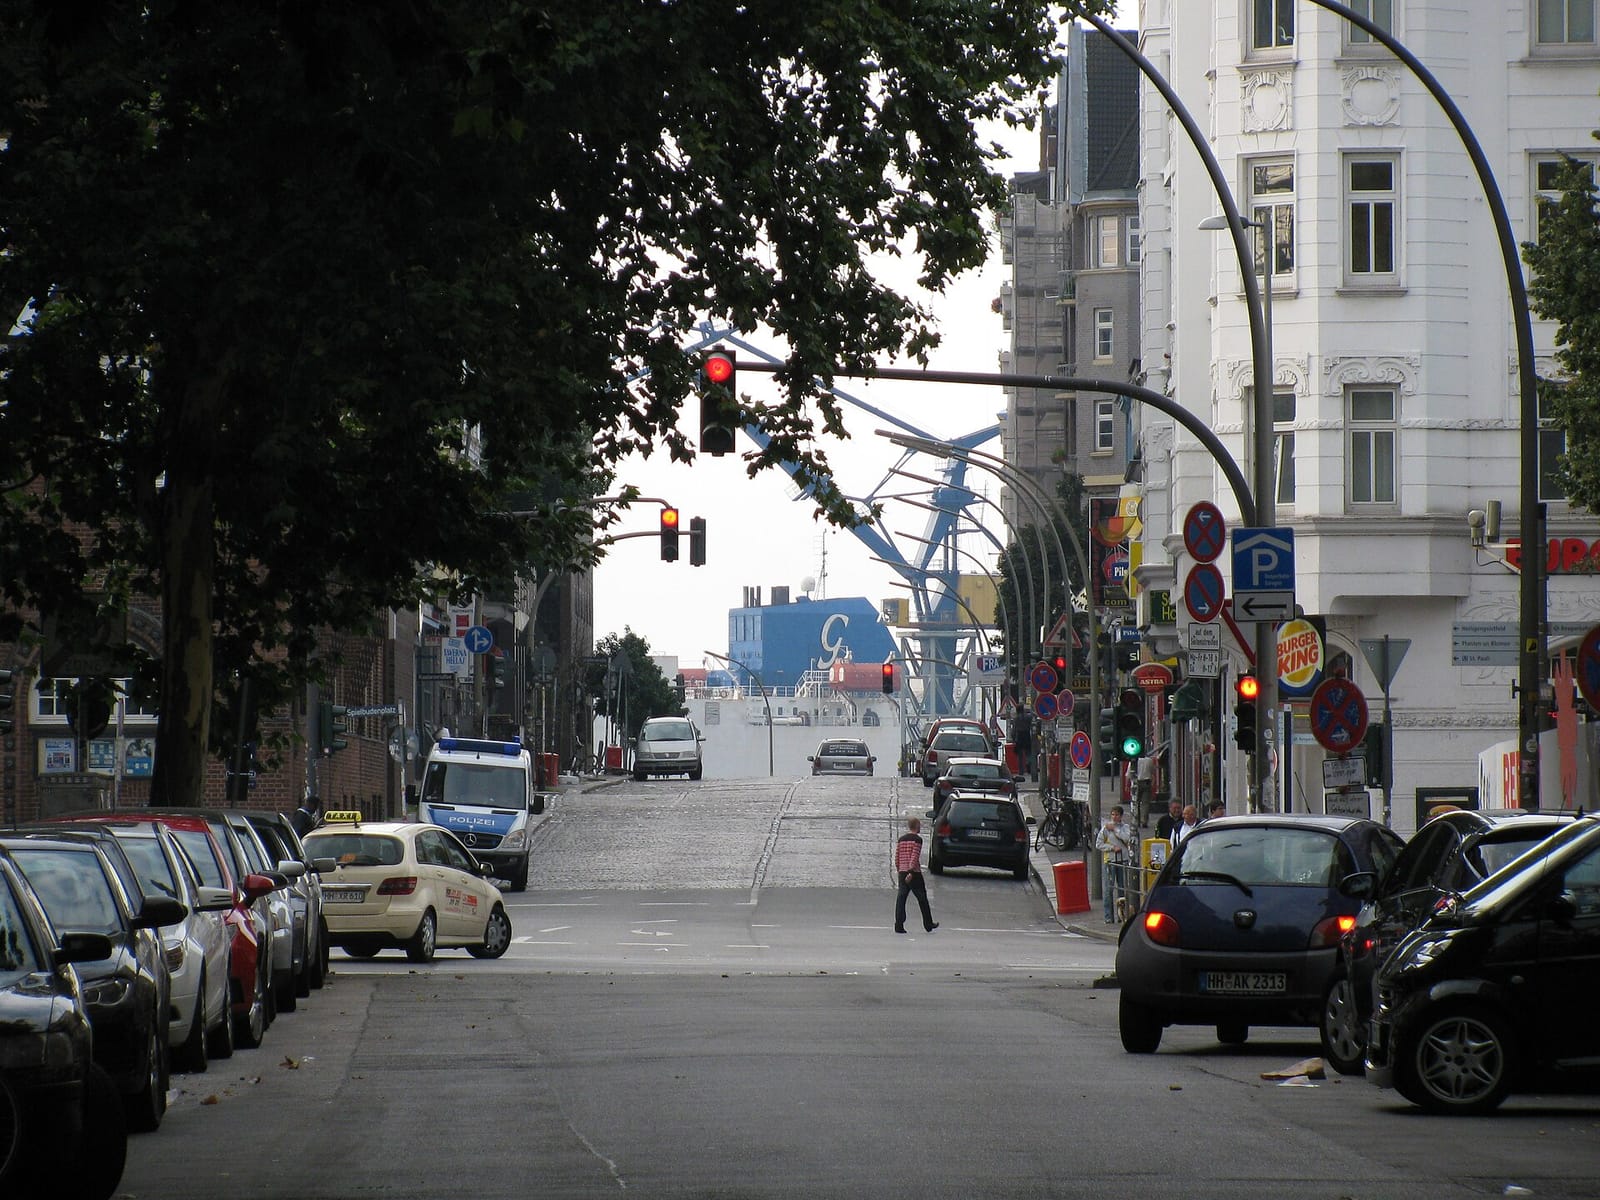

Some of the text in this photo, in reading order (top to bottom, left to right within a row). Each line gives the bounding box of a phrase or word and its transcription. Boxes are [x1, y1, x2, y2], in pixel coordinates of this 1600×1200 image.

[1276, 631, 1317, 657] BURGER
[1277, 645, 1318, 678] KING
[346, 706, 397, 717] Spielbudenplatz
[449, 816, 495, 826] POLIZEI
[1207, 973, 1285, 990] HH AK 2313
